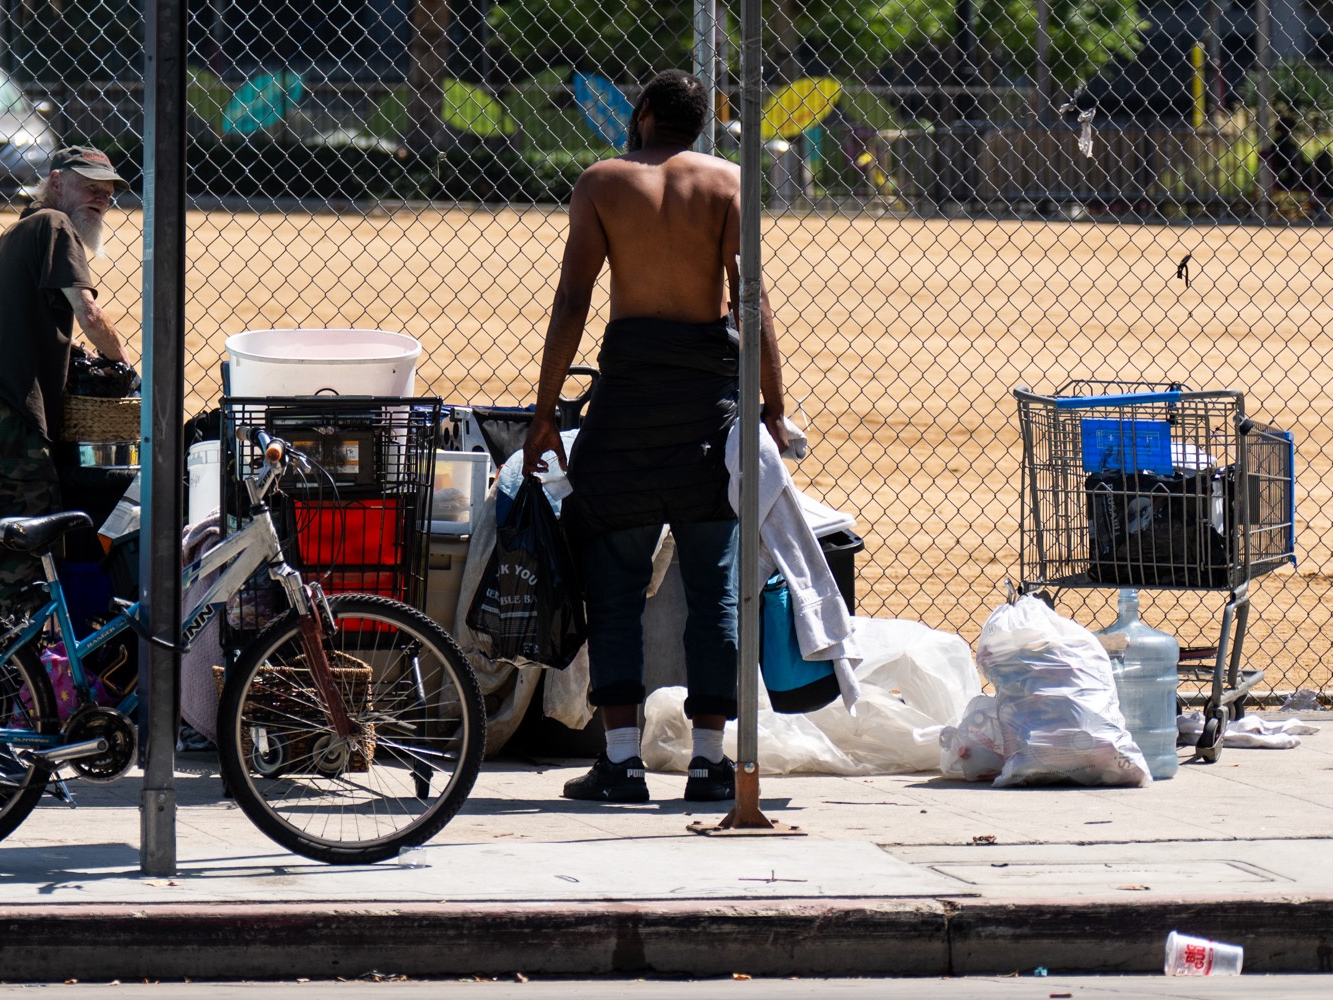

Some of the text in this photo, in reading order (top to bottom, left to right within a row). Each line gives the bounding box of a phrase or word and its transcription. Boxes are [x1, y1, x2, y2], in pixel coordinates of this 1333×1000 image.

[514, 564, 538, 586] YOU
[524, 594, 538, 604] BA
[627, 768, 645, 778] PUM
[1194, 946, 1206, 970] GUL
